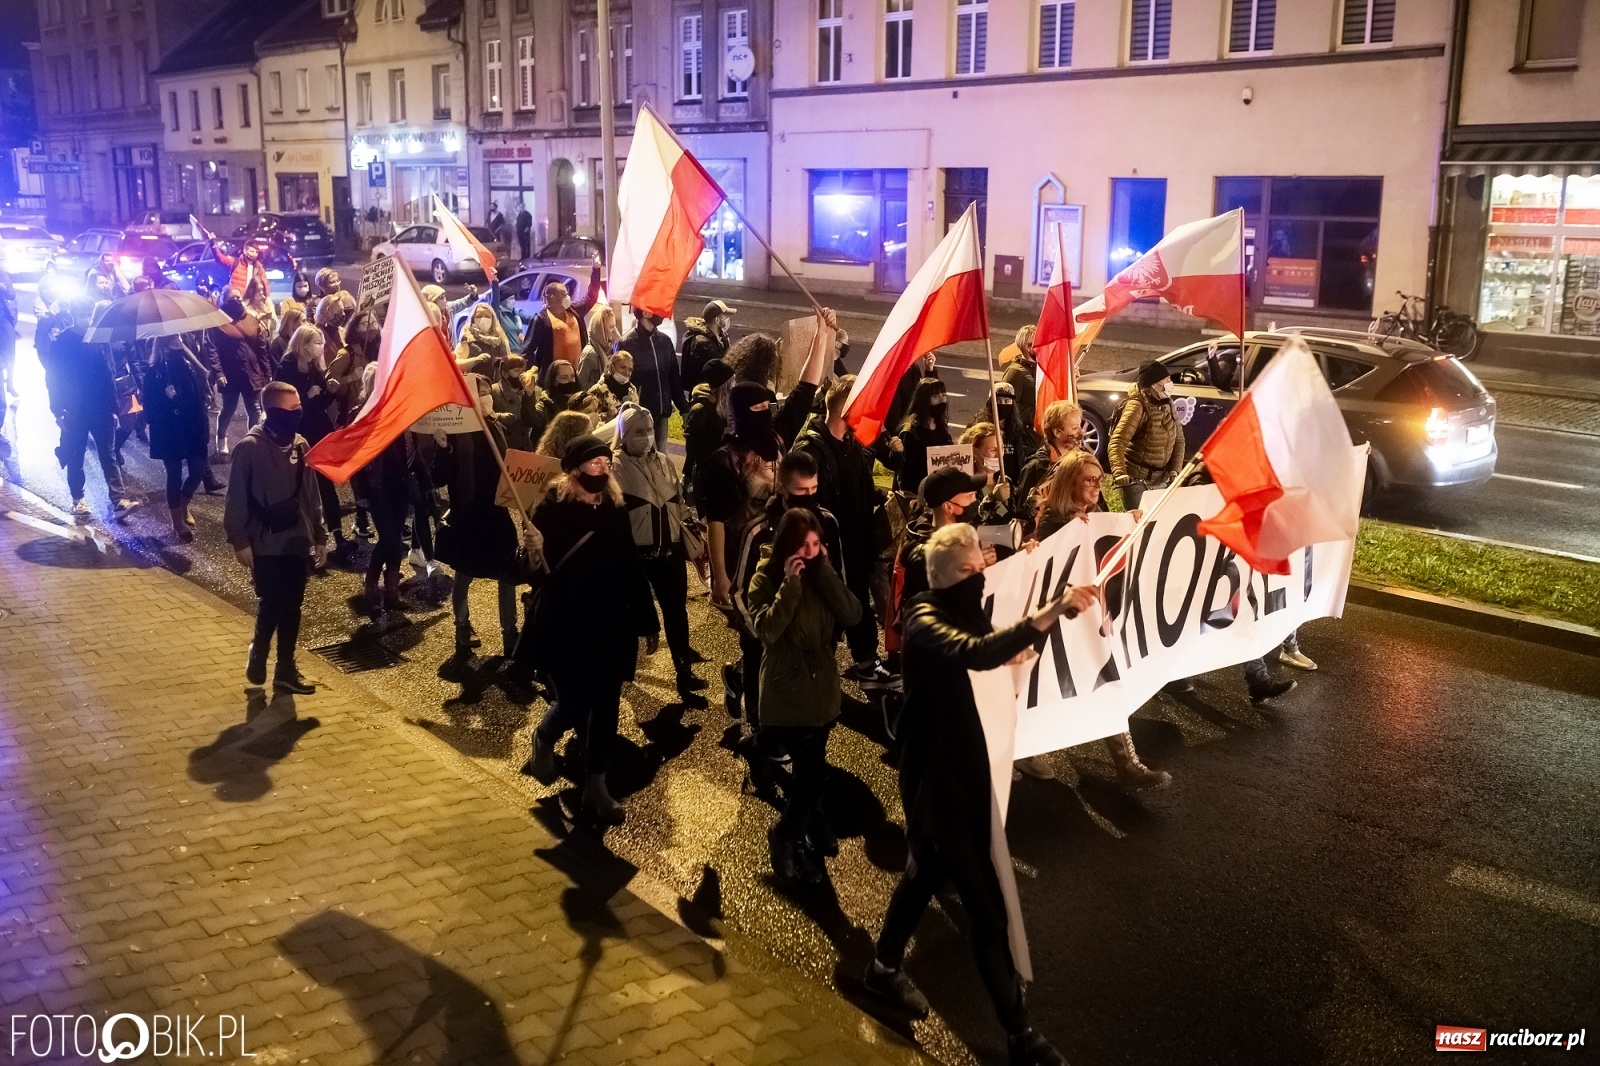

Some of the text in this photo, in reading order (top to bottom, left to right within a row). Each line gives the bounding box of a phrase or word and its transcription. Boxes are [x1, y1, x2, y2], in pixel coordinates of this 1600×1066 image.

[48, 164, 70, 172] Opole
[372, 163, 383, 179] P
[507, 465, 546, 485] WYBÓR
